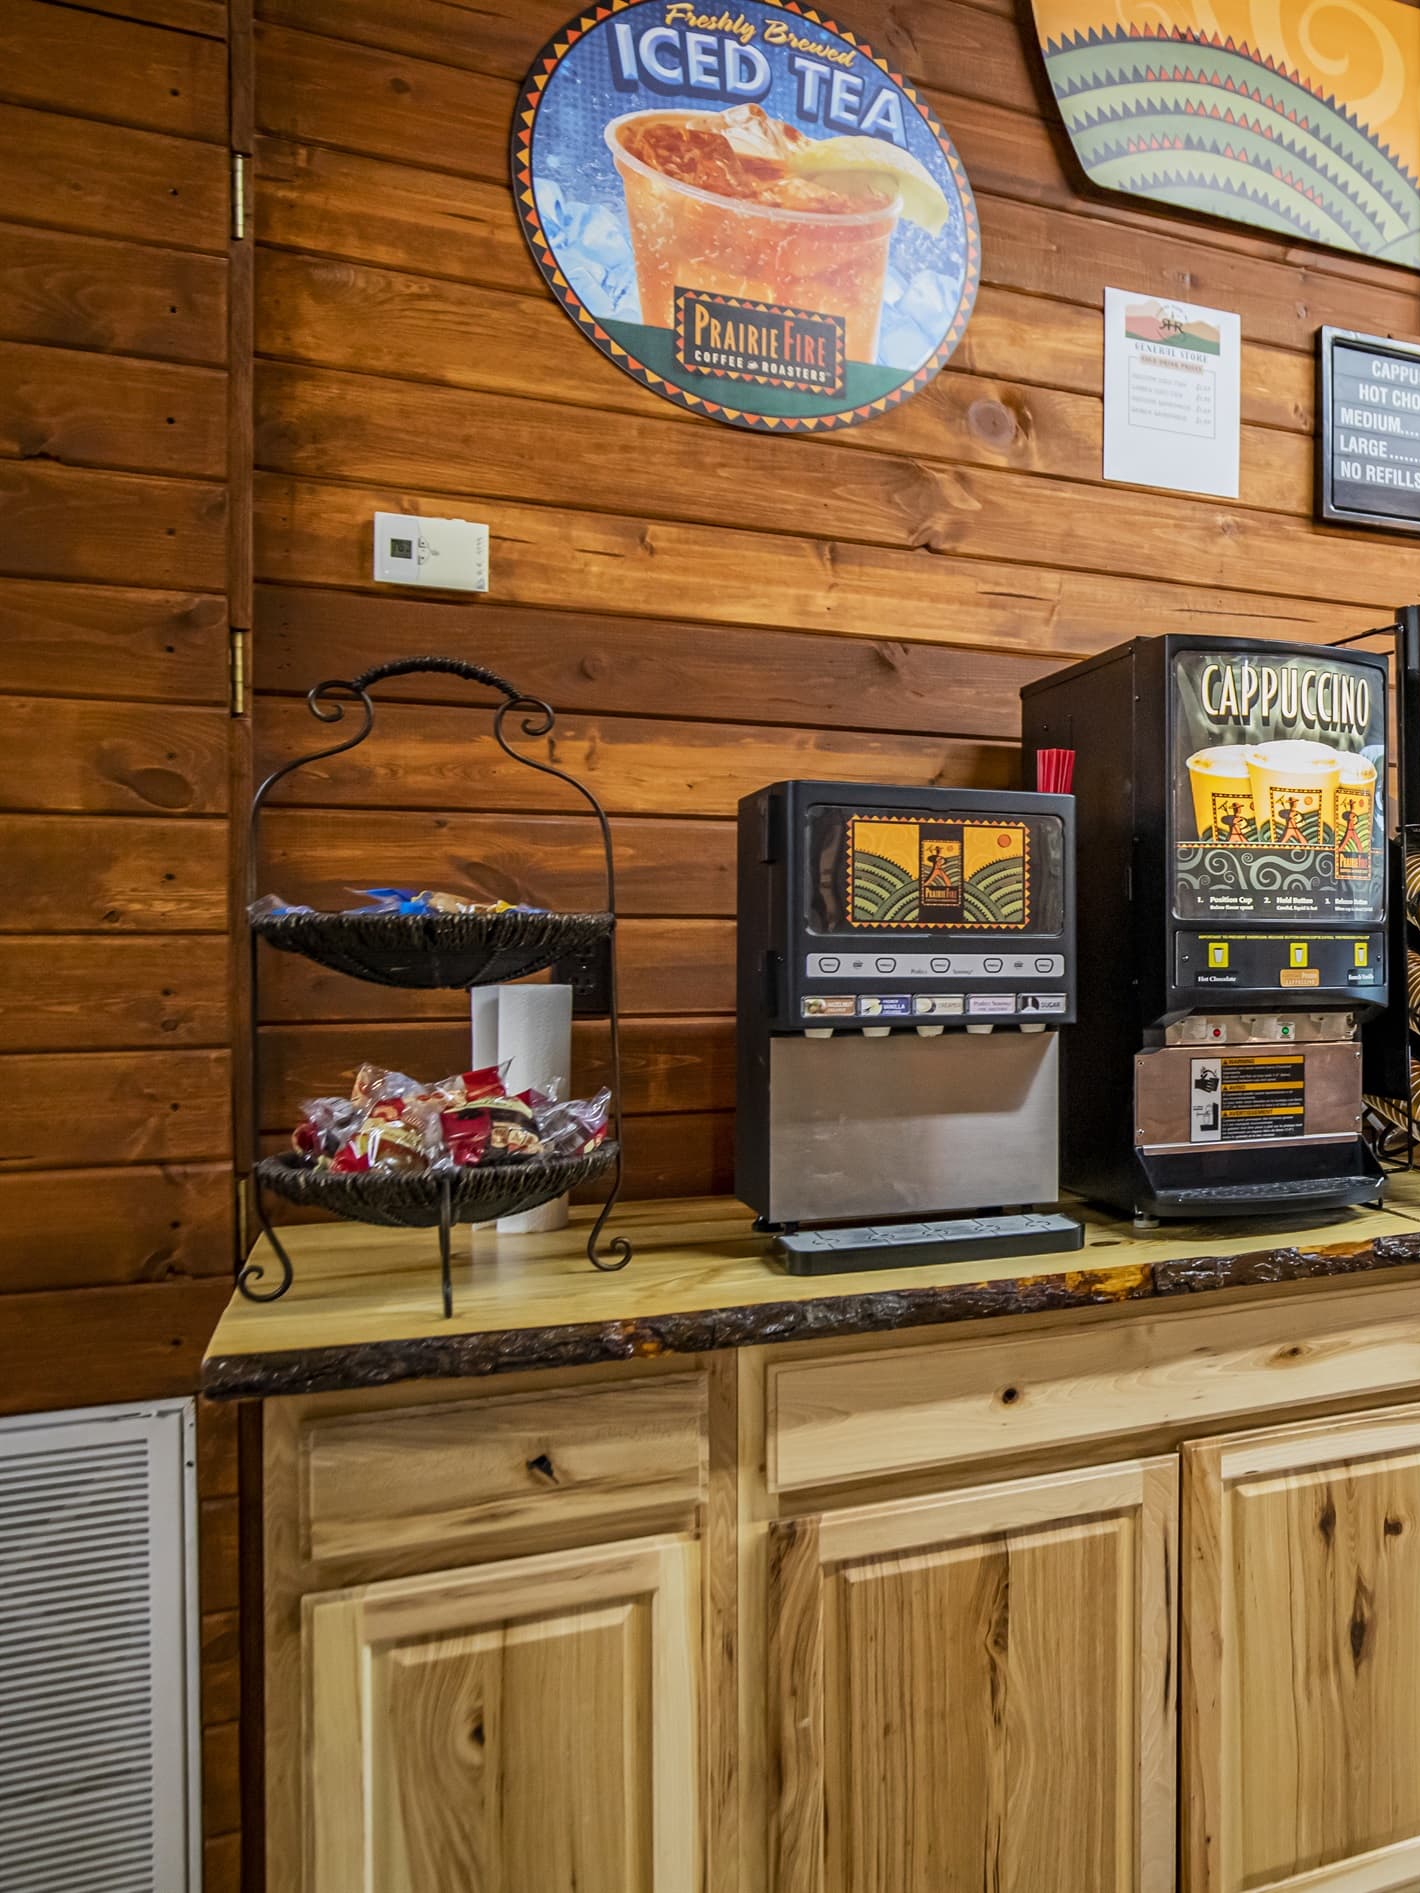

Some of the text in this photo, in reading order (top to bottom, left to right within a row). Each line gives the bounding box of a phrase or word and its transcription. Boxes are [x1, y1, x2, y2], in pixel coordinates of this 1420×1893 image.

[665, 3, 856, 69] Freshly Brewed
[611, 22, 904, 144] ICED TEA
[694, 303, 826, 368] PRAIRIE FIRE
[694, 350, 826, 383] COFFEE ROASTERS
[1358, 383, 1389, 405] HOT
[1340, 407, 1401, 433] MEDIUM
[1339, 434, 1388, 459] LARGE
[1340, 461, 1362, 480] NO
[1201, 664, 1370, 732] CAPPUCCINO
[1239, 896, 1253, 905] Cup
